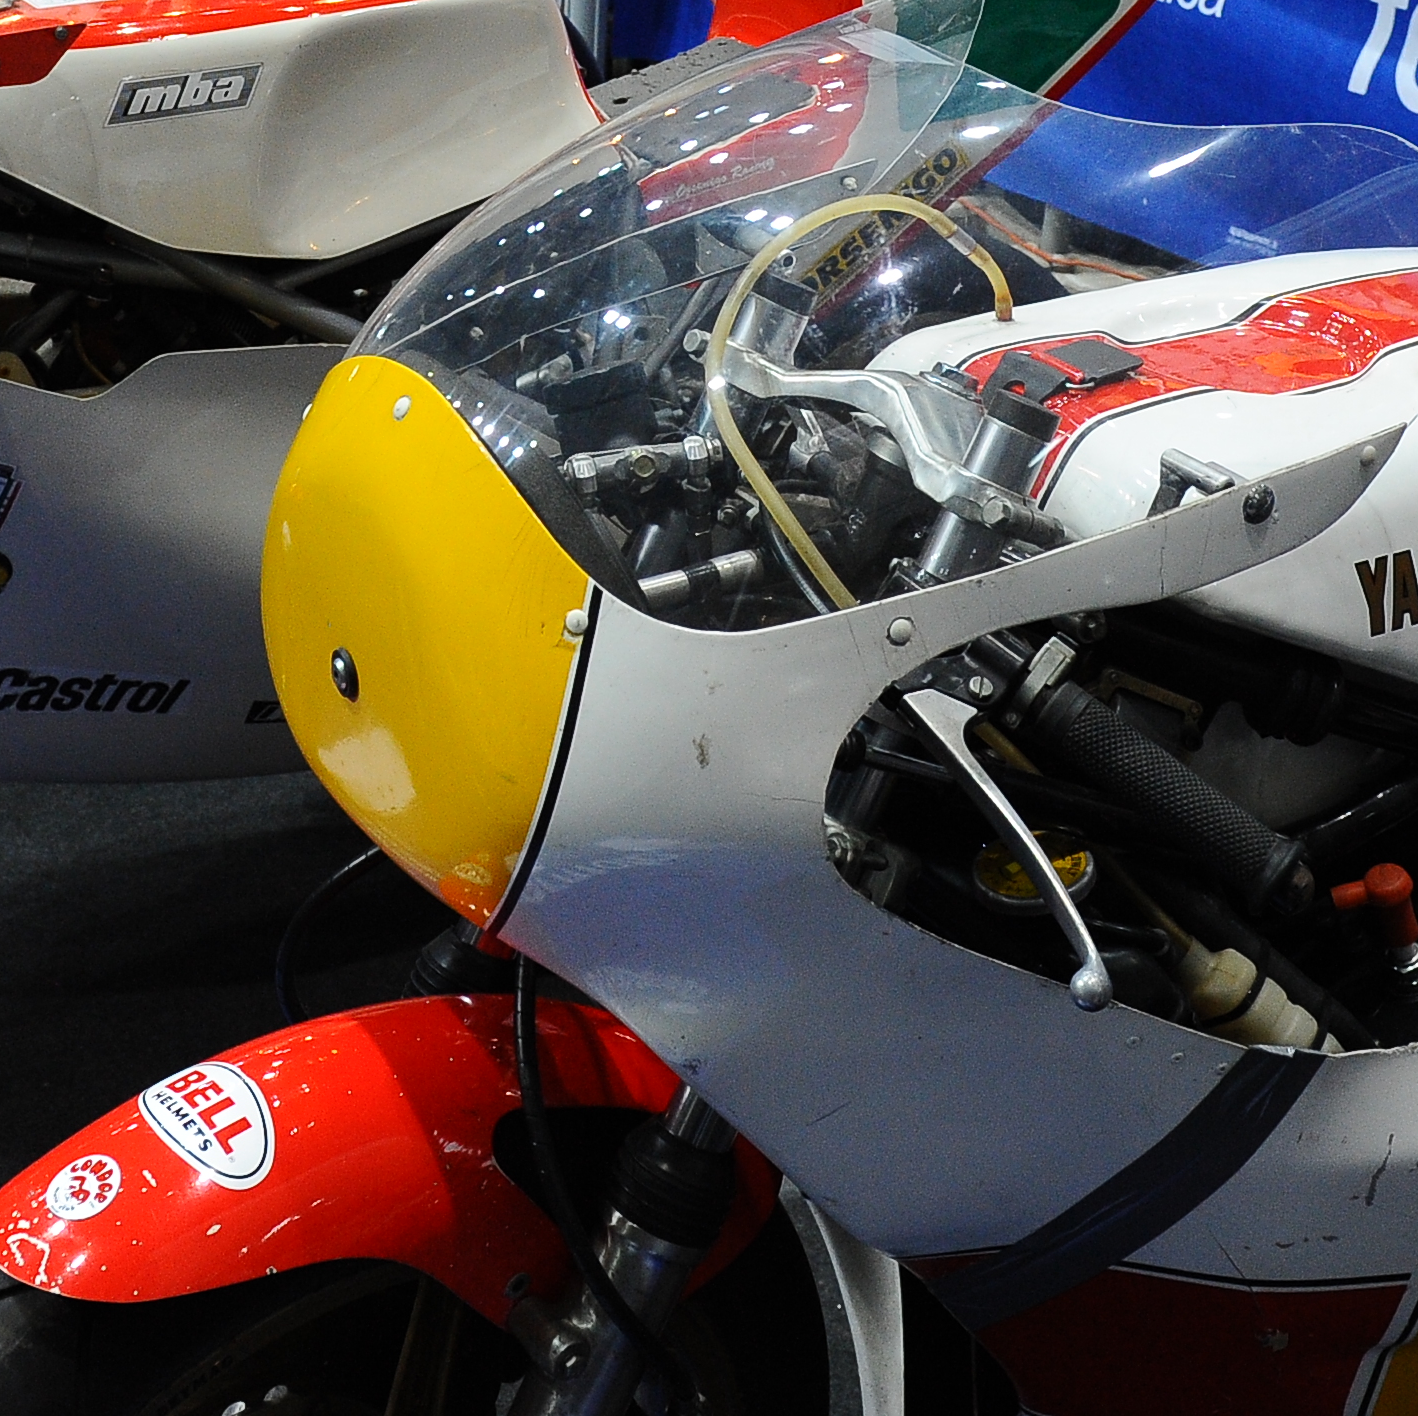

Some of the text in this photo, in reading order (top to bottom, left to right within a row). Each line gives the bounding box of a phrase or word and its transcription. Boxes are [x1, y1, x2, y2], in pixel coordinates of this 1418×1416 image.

[128, 73, 248, 116] mba
[151, 1090, 213, 1153] HELMETS
[166, 1070, 252, 1157] BELL
